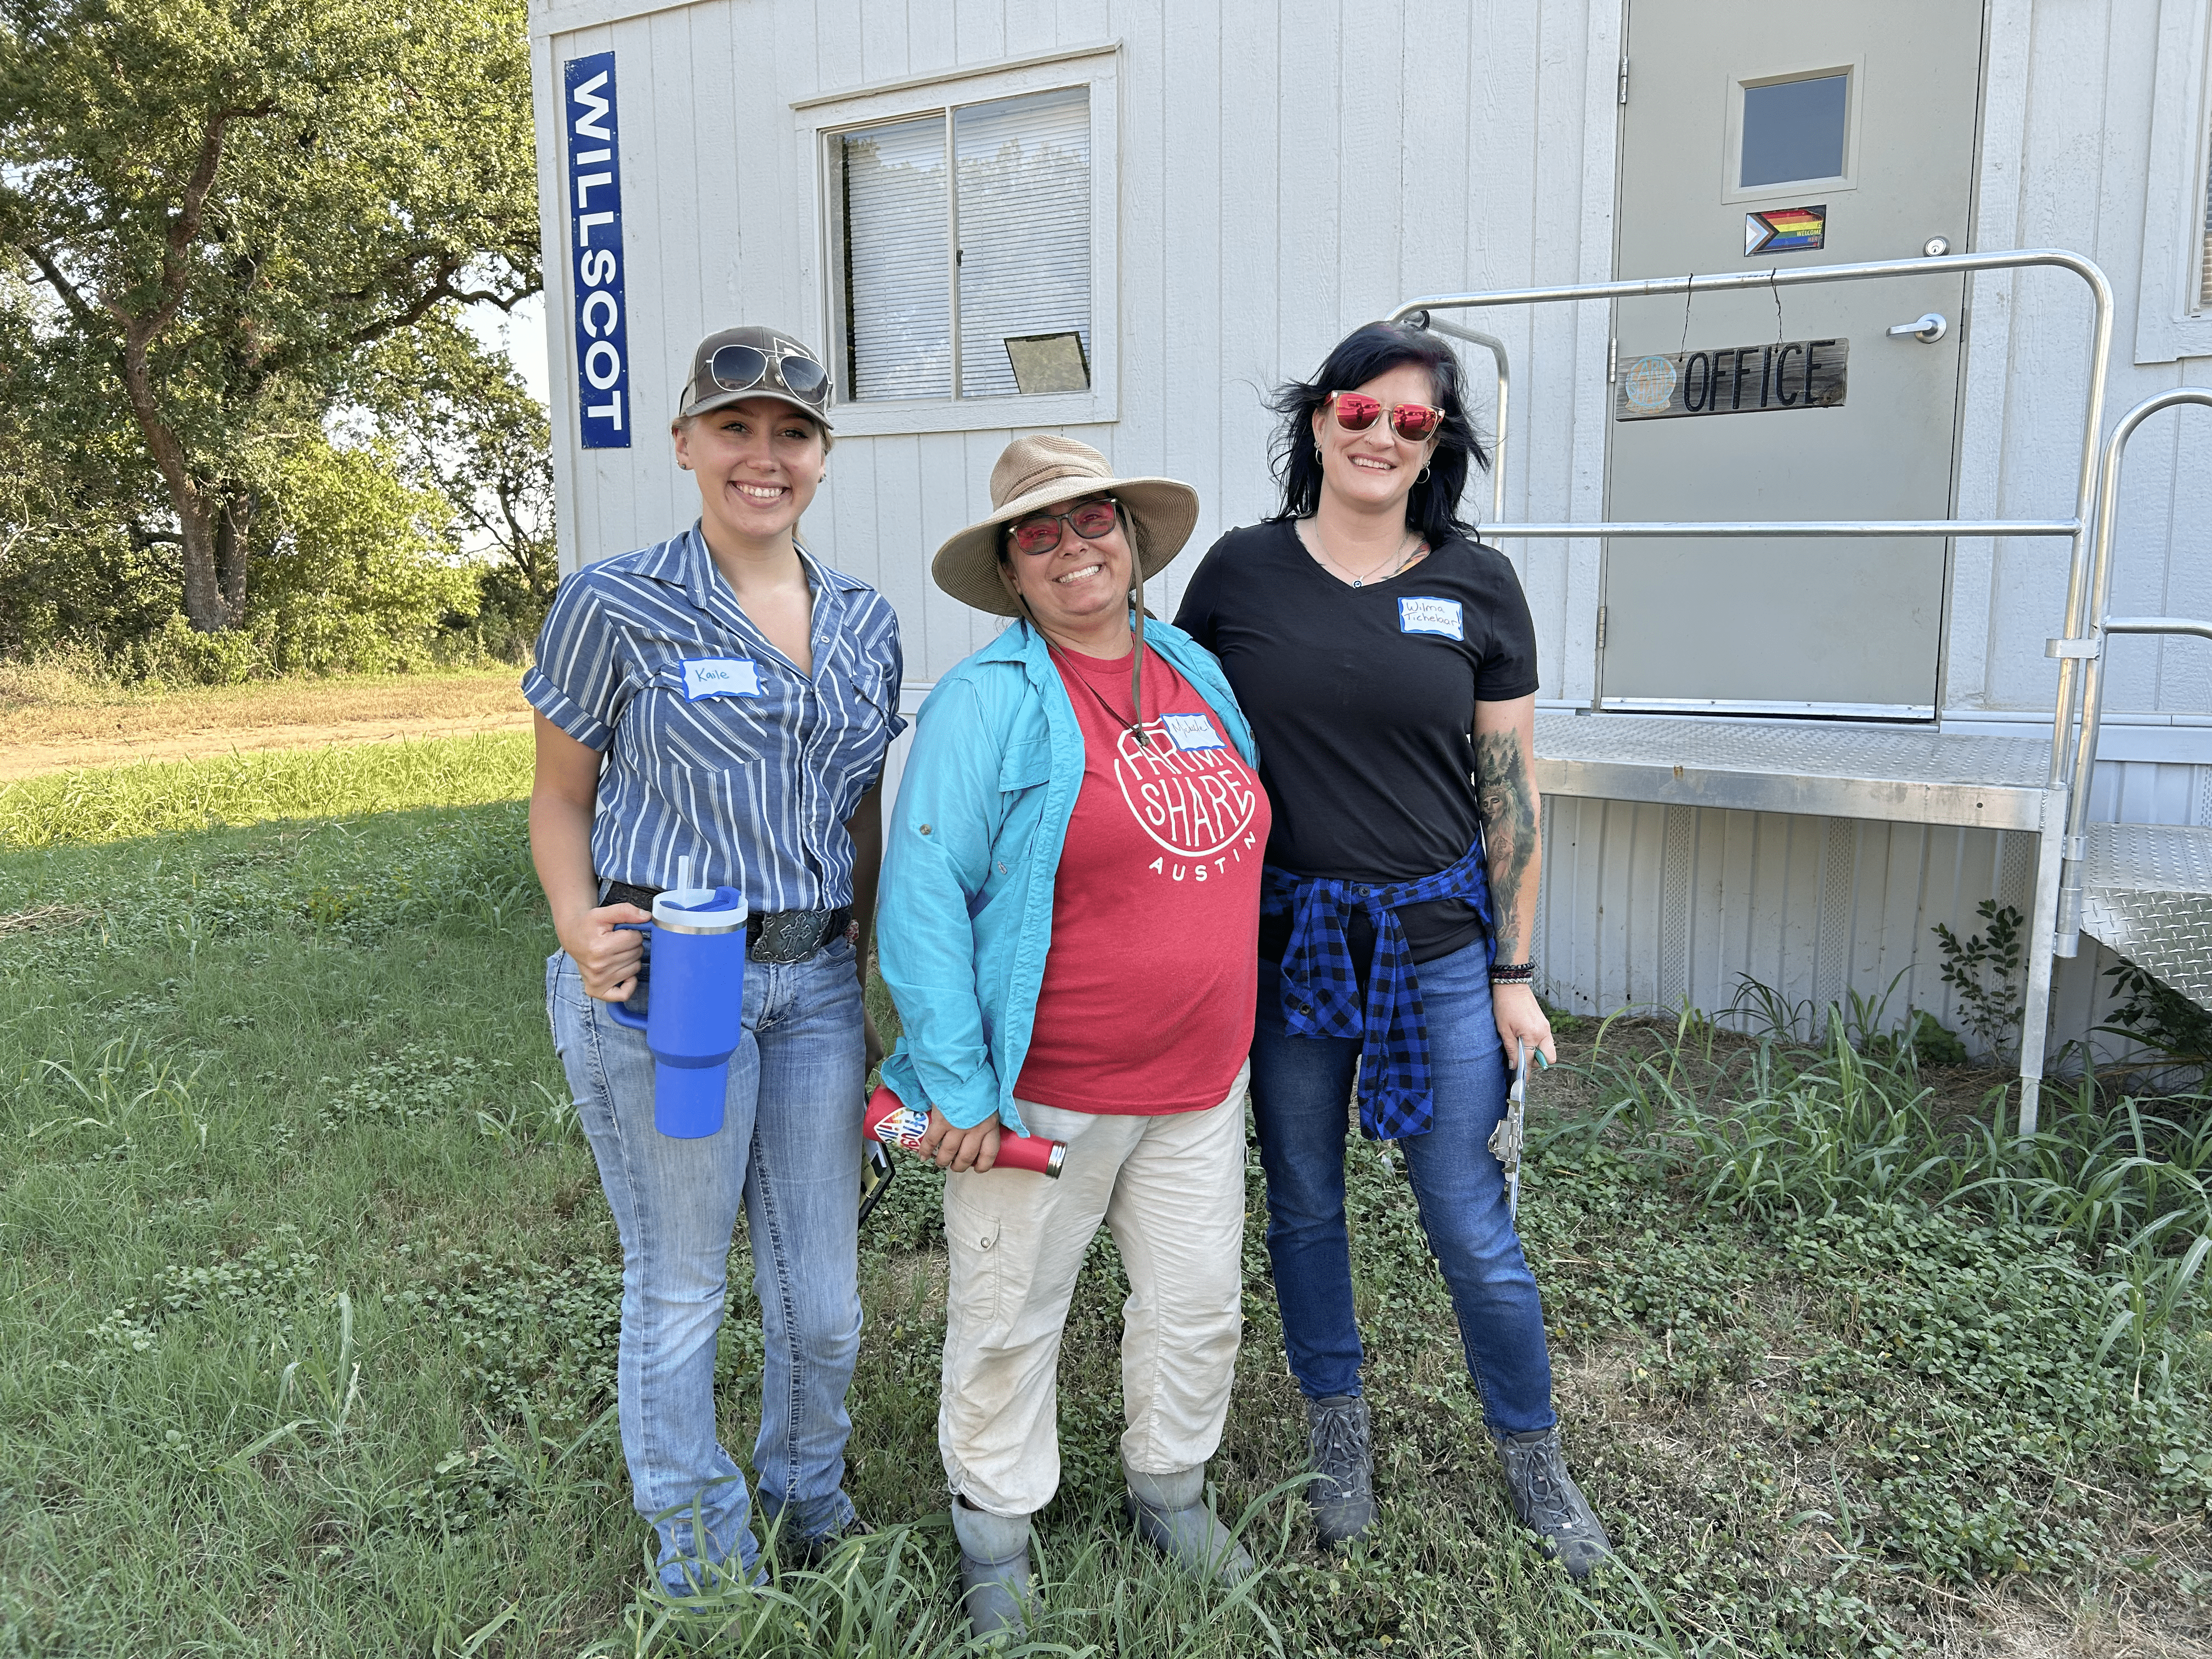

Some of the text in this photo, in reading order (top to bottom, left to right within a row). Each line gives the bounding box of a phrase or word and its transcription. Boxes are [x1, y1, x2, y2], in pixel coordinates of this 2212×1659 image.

[574, 70, 622, 431] WILLSCOT
[1797, 229, 1822, 237] WELCOME
[1684, 340, 1836, 412] OFFICE
[1406, 601, 1445, 613] Wilma
[695, 668, 730, 682] Kaile
[1141, 769, 1252, 847] SHARE
[1149, 831, 1256, 882] AUSTIN
